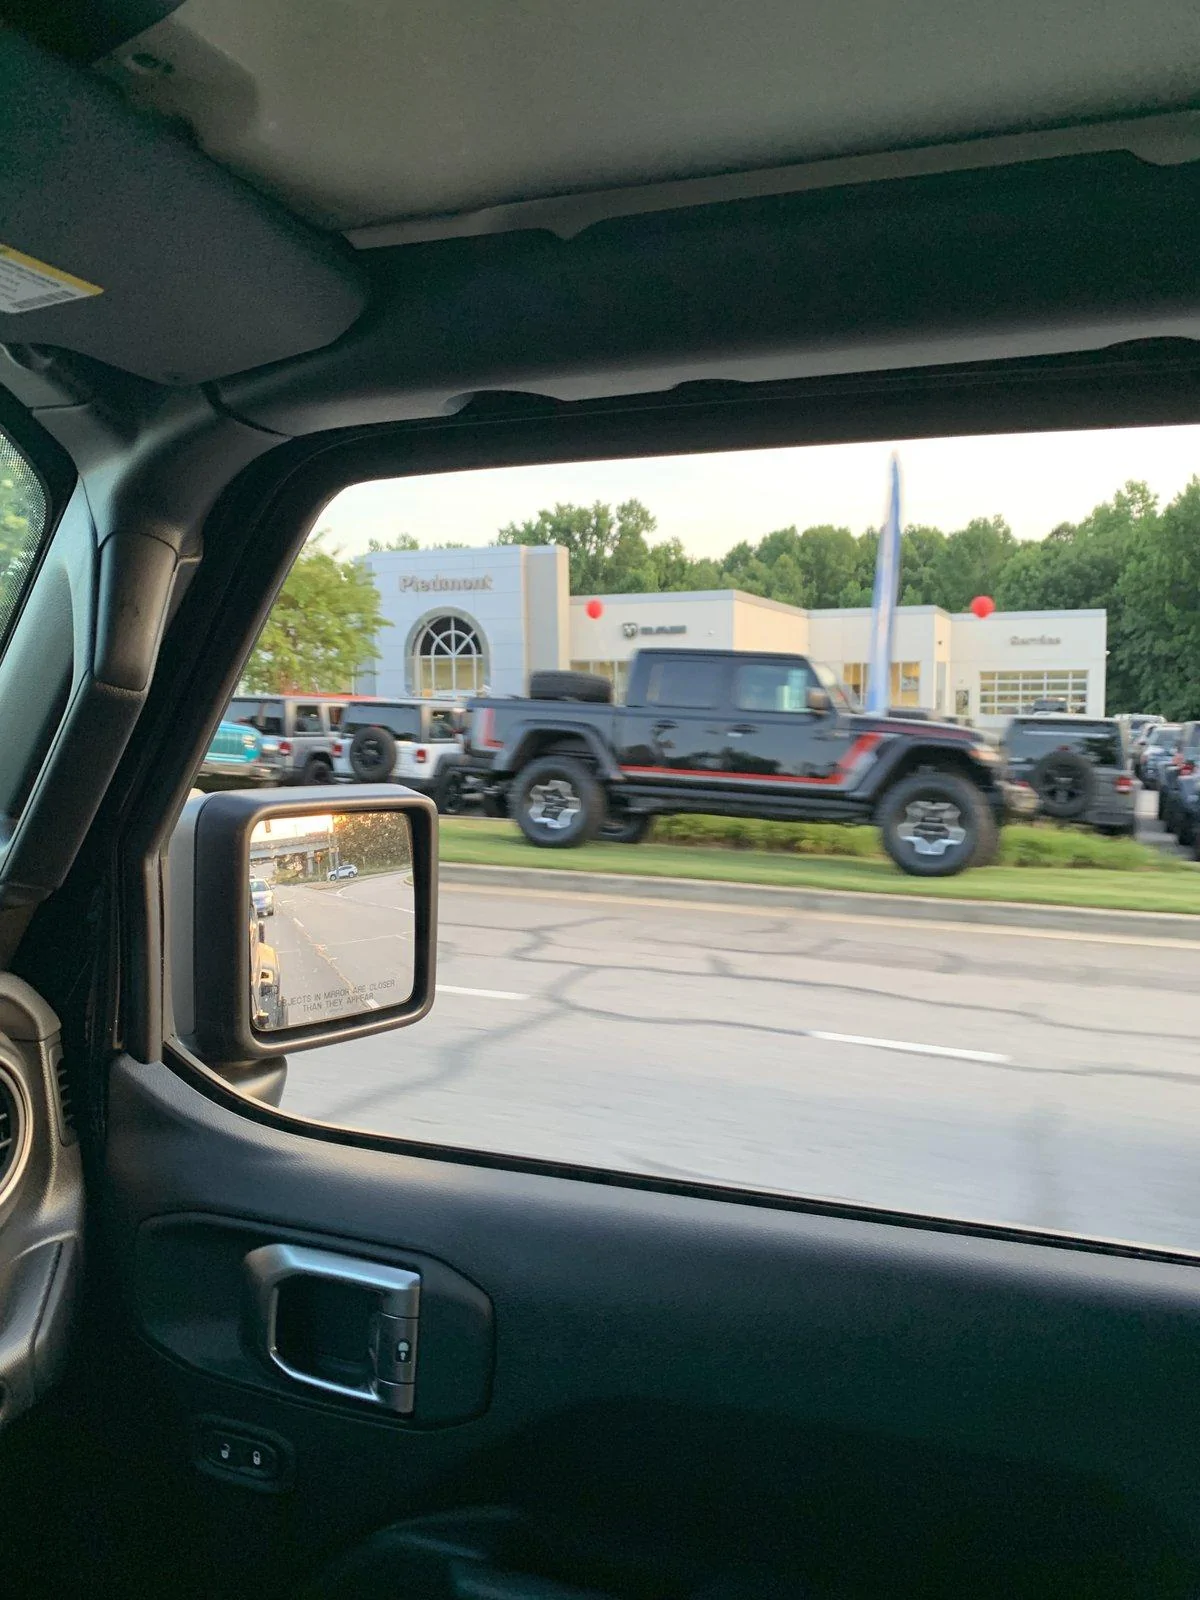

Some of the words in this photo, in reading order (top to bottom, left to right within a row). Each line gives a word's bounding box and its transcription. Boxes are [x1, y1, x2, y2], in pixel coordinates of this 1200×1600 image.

[399, 574, 494, 593] Piedmont
[277, 994, 312, 1008] OBJECTS
[314, 993, 321, 1002] IN
[324, 988, 350, 1000] MIRROR
[352, 984, 367, 994] ARE
[369, 979, 395, 992] CLOSER
[303, 1002, 322, 1013] THAN
[326, 998, 343, 1009] THEY
[347, 992, 374, 1005] APPEAR
